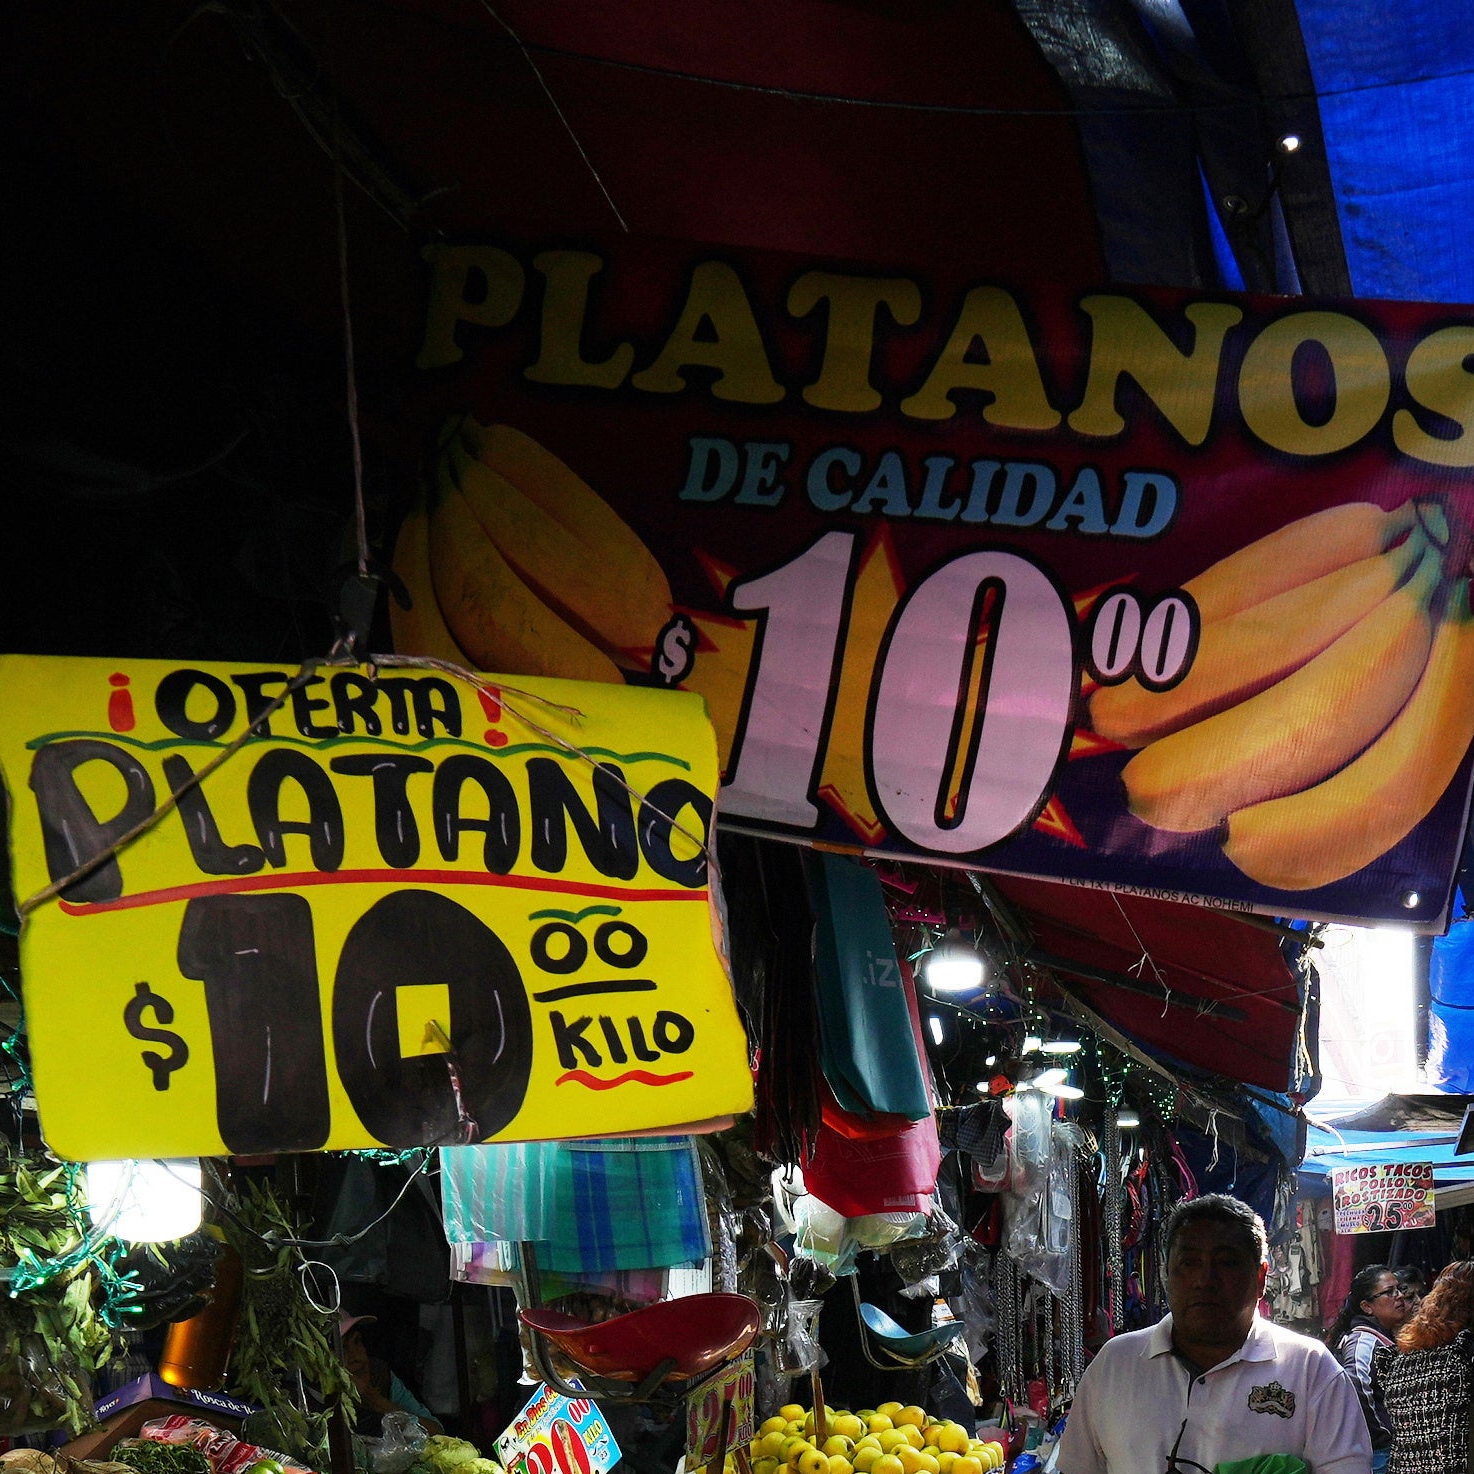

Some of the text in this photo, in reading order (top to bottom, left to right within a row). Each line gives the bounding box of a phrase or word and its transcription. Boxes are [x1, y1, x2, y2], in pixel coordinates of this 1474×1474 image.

[678, 436, 1182, 539] DE CALIDAD
[28, 740, 714, 903] PLATANO
[1114, 883, 1179, 901] PLATANOS
[1181, 893, 1199, 905] AC
[1203, 895, 1254, 914] NOHEMI
[550, 1010, 695, 1070] KILO
[1335, 1164, 1433, 1186] RICOS TACOS
[1359, 1177, 1406, 1191] POLLO
[1341, 1188, 1426, 1209] ROSTIZADO
[190, 1389, 228, 1409] Rosca
